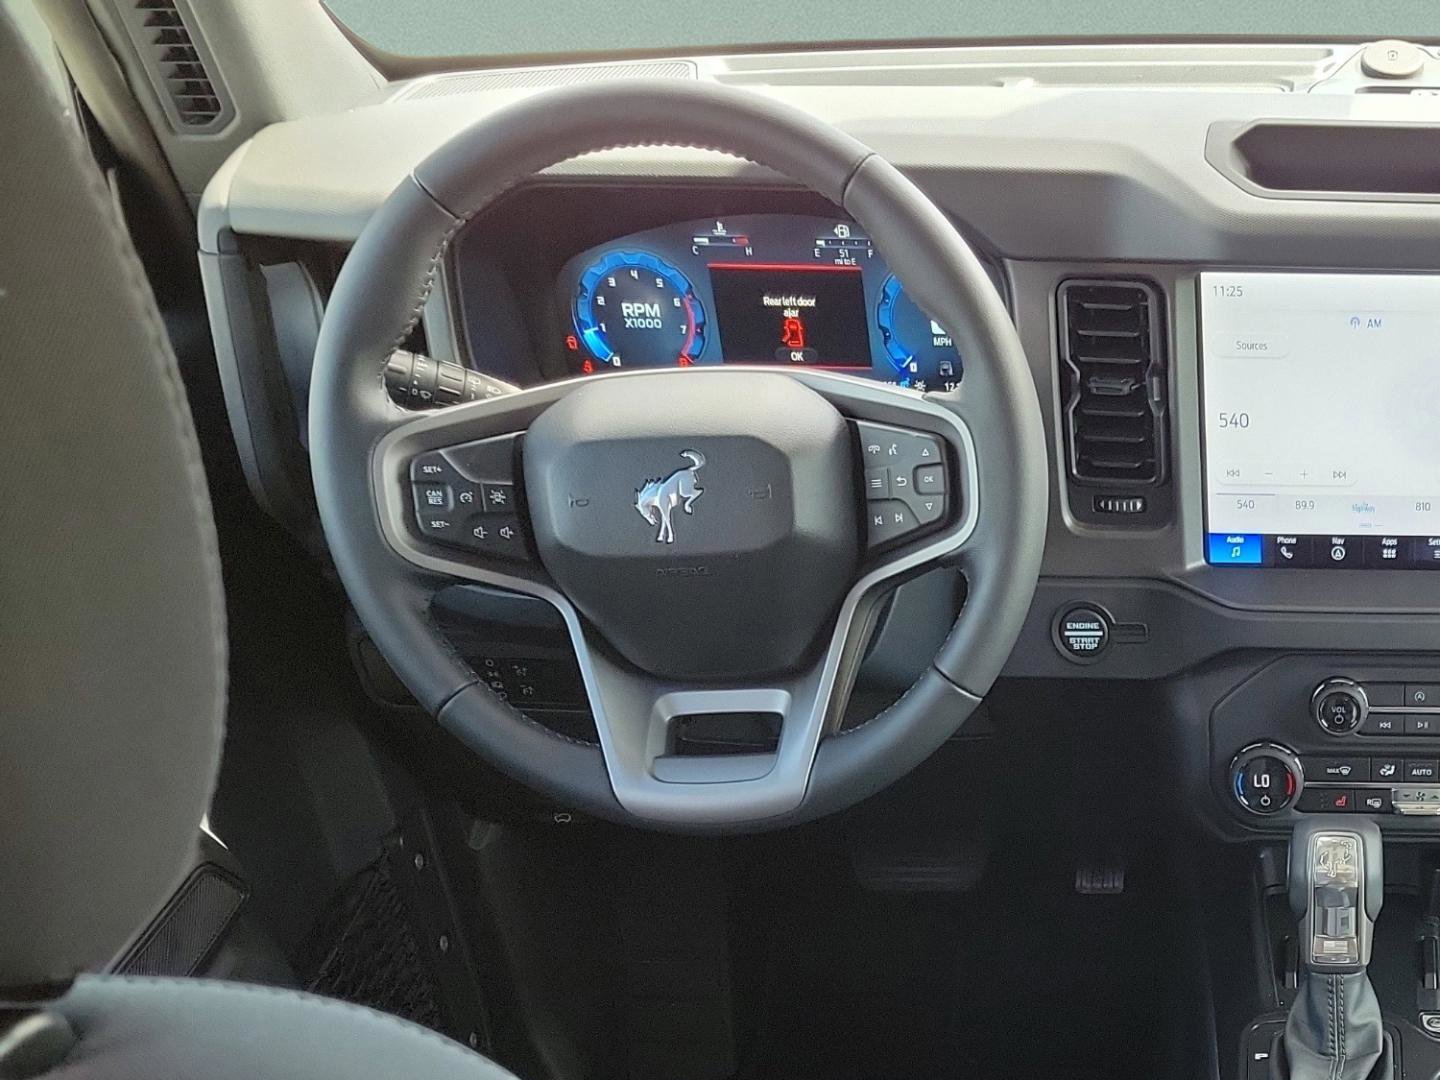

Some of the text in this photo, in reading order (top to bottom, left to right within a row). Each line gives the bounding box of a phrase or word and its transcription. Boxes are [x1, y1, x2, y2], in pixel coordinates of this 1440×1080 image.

[692, 246, 698, 255] C
[746, 246, 752, 256] H
[814, 248, 820, 258] E
[630, 270, 638, 280] 4
[608, 277, 616, 287] 3
[656, 278, 664, 288] 5
[1213, 285, 1243, 298] 11:25
[596, 296, 605, 306] 2
[674, 297, 681, 307] 6
[762, 296, 816, 308] Rear left door
[621, 302, 661, 318] RPM
[783, 308, 800, 318] ajar
[624, 318, 662, 328] X1000
[1366, 318, 1382, 329] AM
[932, 337, 952, 346] MPH
[1236, 340, 1268, 351] Sources
[612, 356, 621, 367] 0
[790, 352, 804, 362] OK
[910, 362, 918, 372] 0
[1218, 412, 1250, 428] 540
[1237, 500, 1254, 510] 540
[1295, 500, 1315, 510] 89.9
[1415, 502, 1431, 512] 810
[1226, 536, 1244, 544] Audio
[1277, 536, 1297, 545] Phone
[1332, 537, 1344, 545] Nav
[1382, 538, 1398, 546] Apps
[1253, 774, 1270, 788] LO
